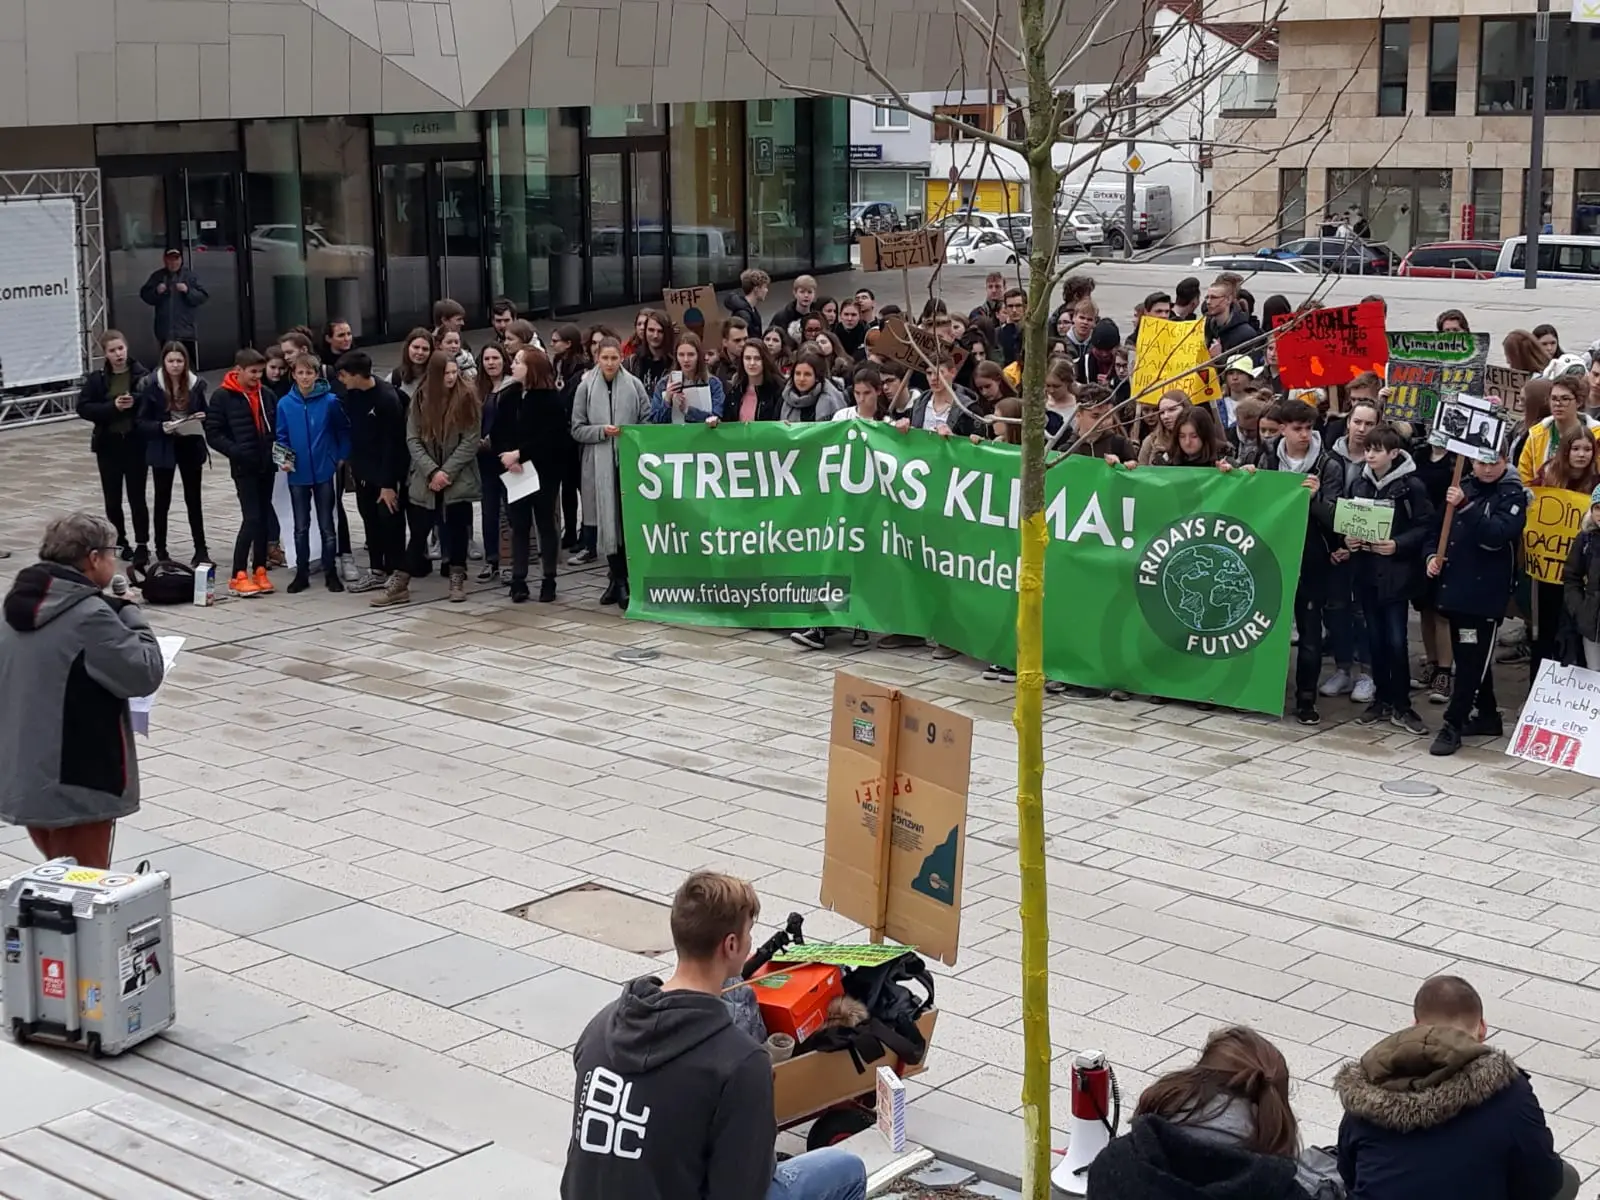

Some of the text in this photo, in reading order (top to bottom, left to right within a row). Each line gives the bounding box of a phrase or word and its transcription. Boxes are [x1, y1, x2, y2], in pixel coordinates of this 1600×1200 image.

[0, 277, 69, 300] ommen!
[637, 449, 801, 500] STREIK
[818, 429, 931, 511] FÜRS
[1538, 495, 1582, 530] Din
[642, 522, 690, 555] Wir
[882, 520, 913, 561] ihr
[921, 534, 1022, 593] handel
[1138, 517, 1256, 586] FRIDAYS FOR
[1526, 530, 1576, 556] DACH
[1525, 552, 1566, 581] HÄTT
[1186, 610, 1272, 655] FUTURE
[1541, 662, 1577, 688] Auch
[1533, 687, 1561, 706] Euch
[1524, 710, 1589, 735] diese eine
